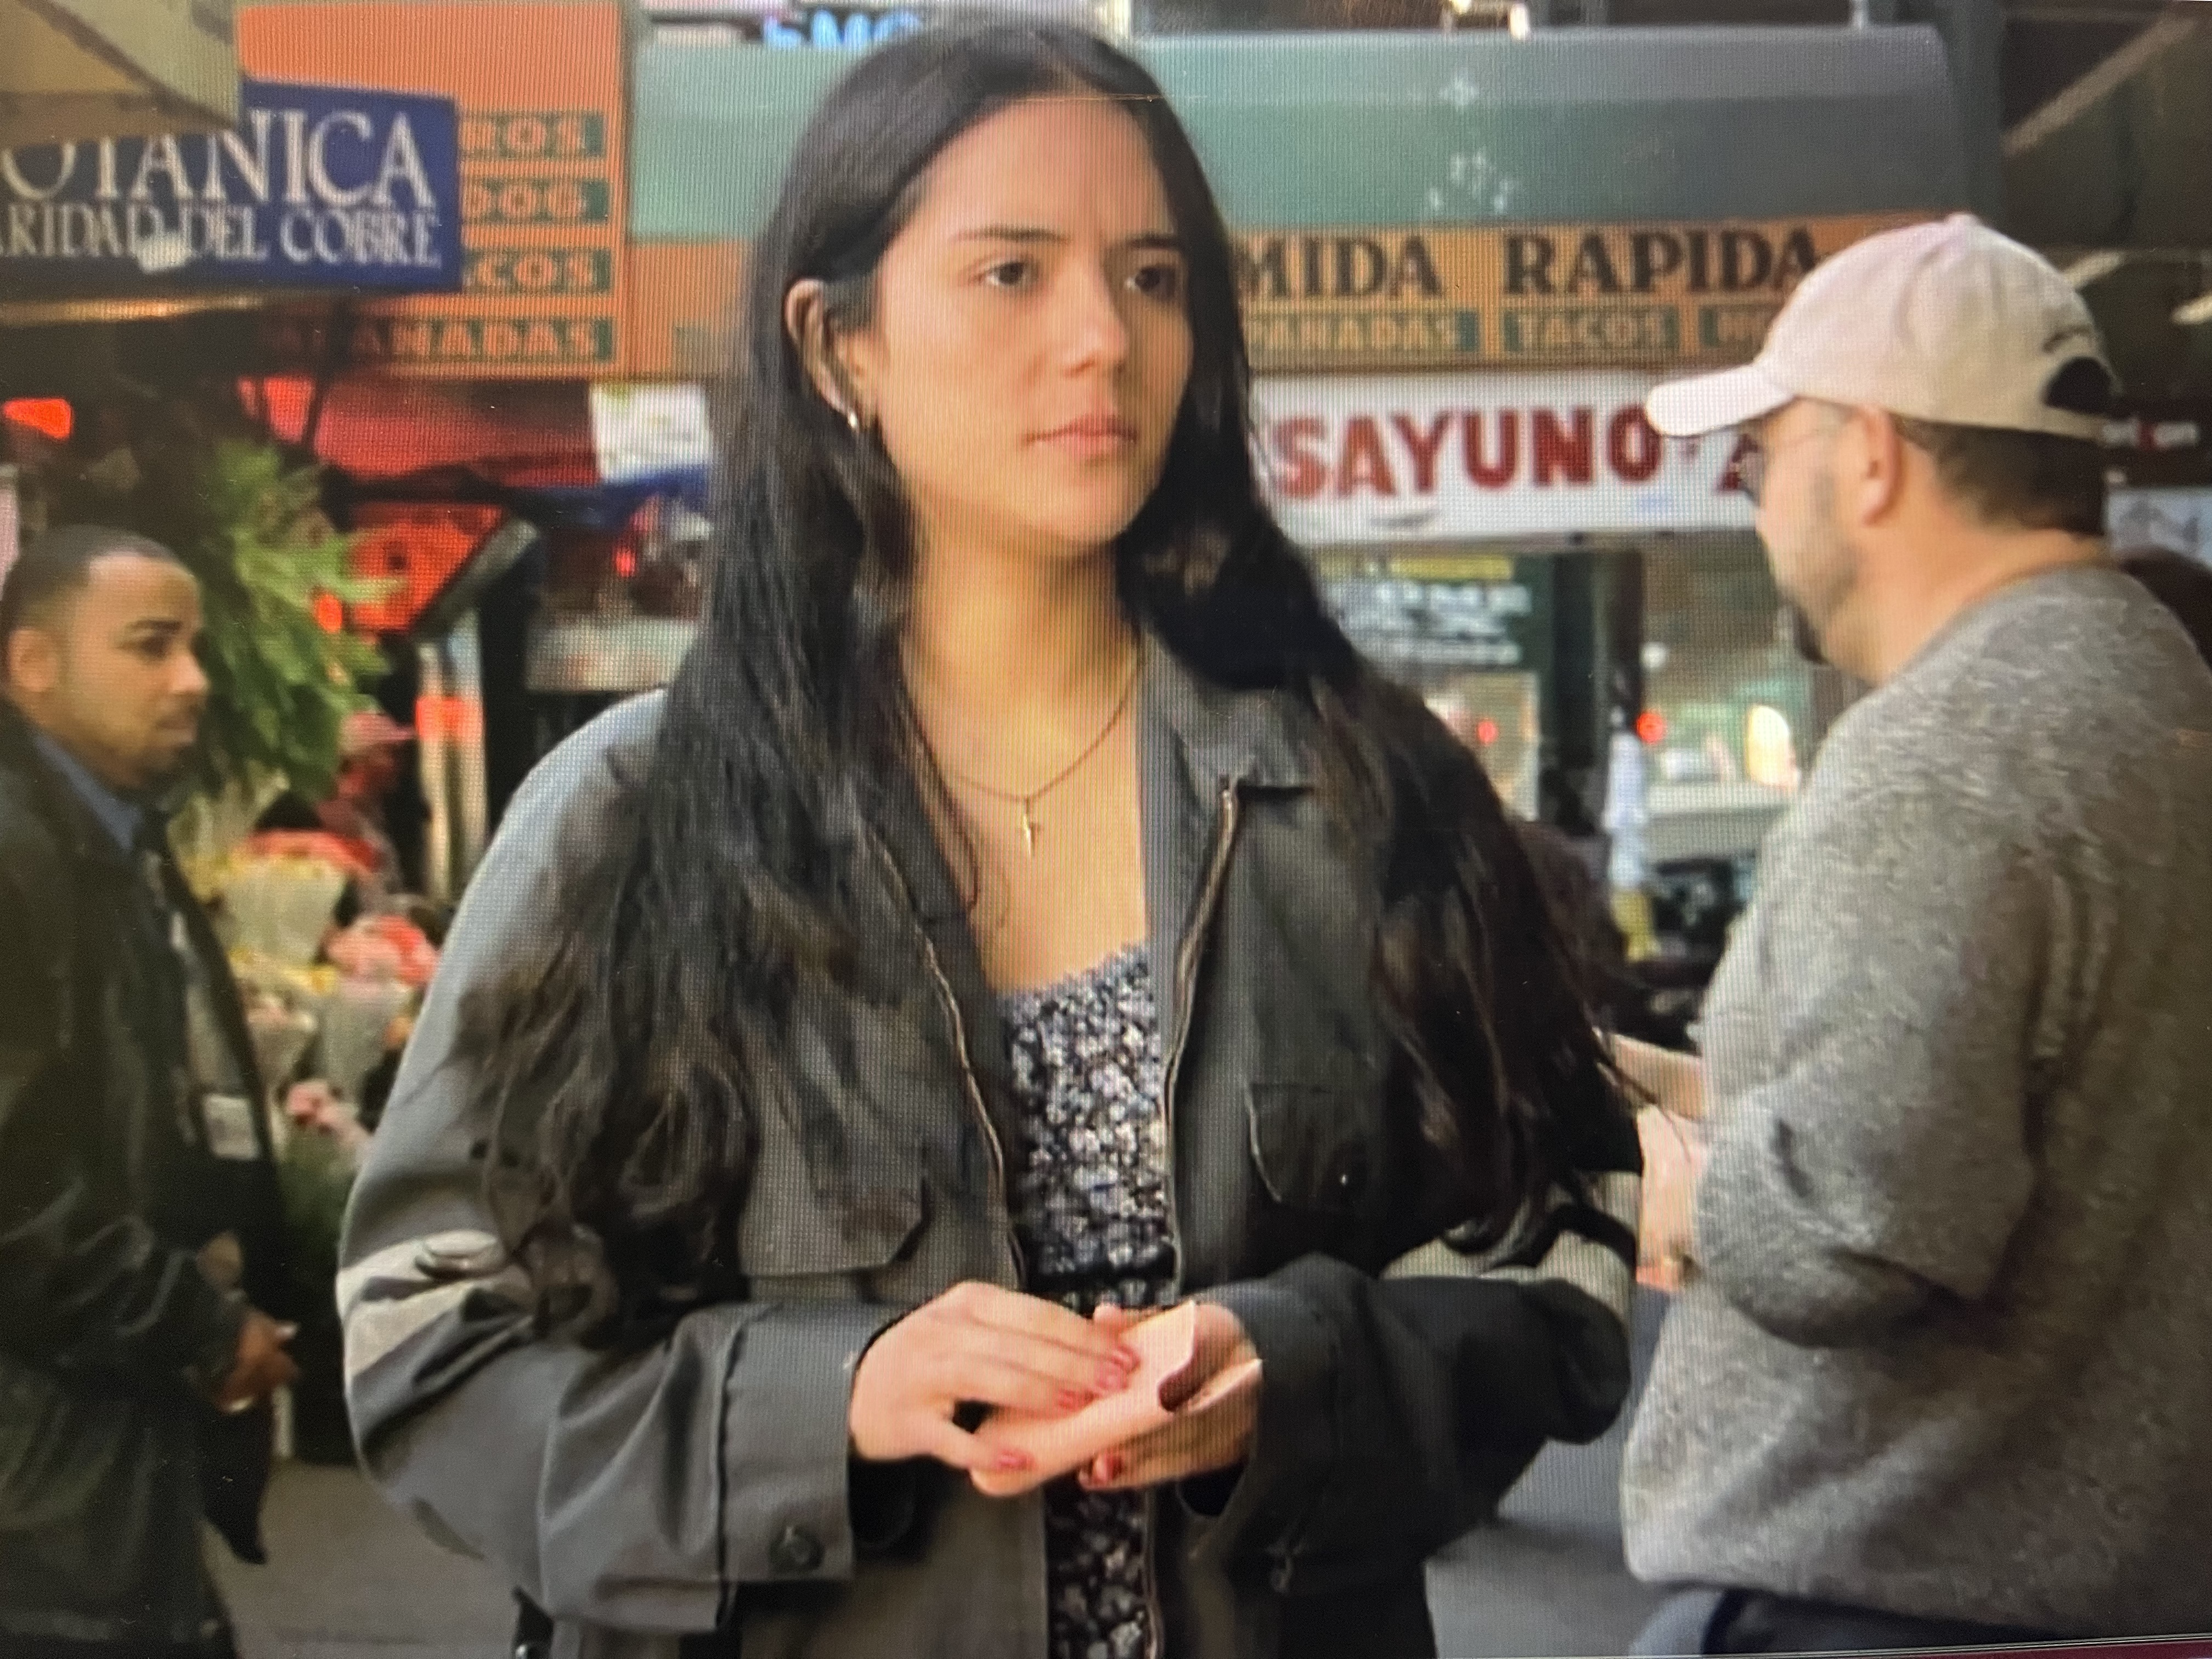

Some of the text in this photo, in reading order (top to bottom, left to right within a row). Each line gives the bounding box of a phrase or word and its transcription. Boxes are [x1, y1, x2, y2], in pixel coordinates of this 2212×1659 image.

[464, 252, 595, 290] COS
[1503, 224, 1818, 298] RAPIDA
[1517, 313, 1664, 349] TACOS
[1269, 404, 1663, 500] SAYUNO
